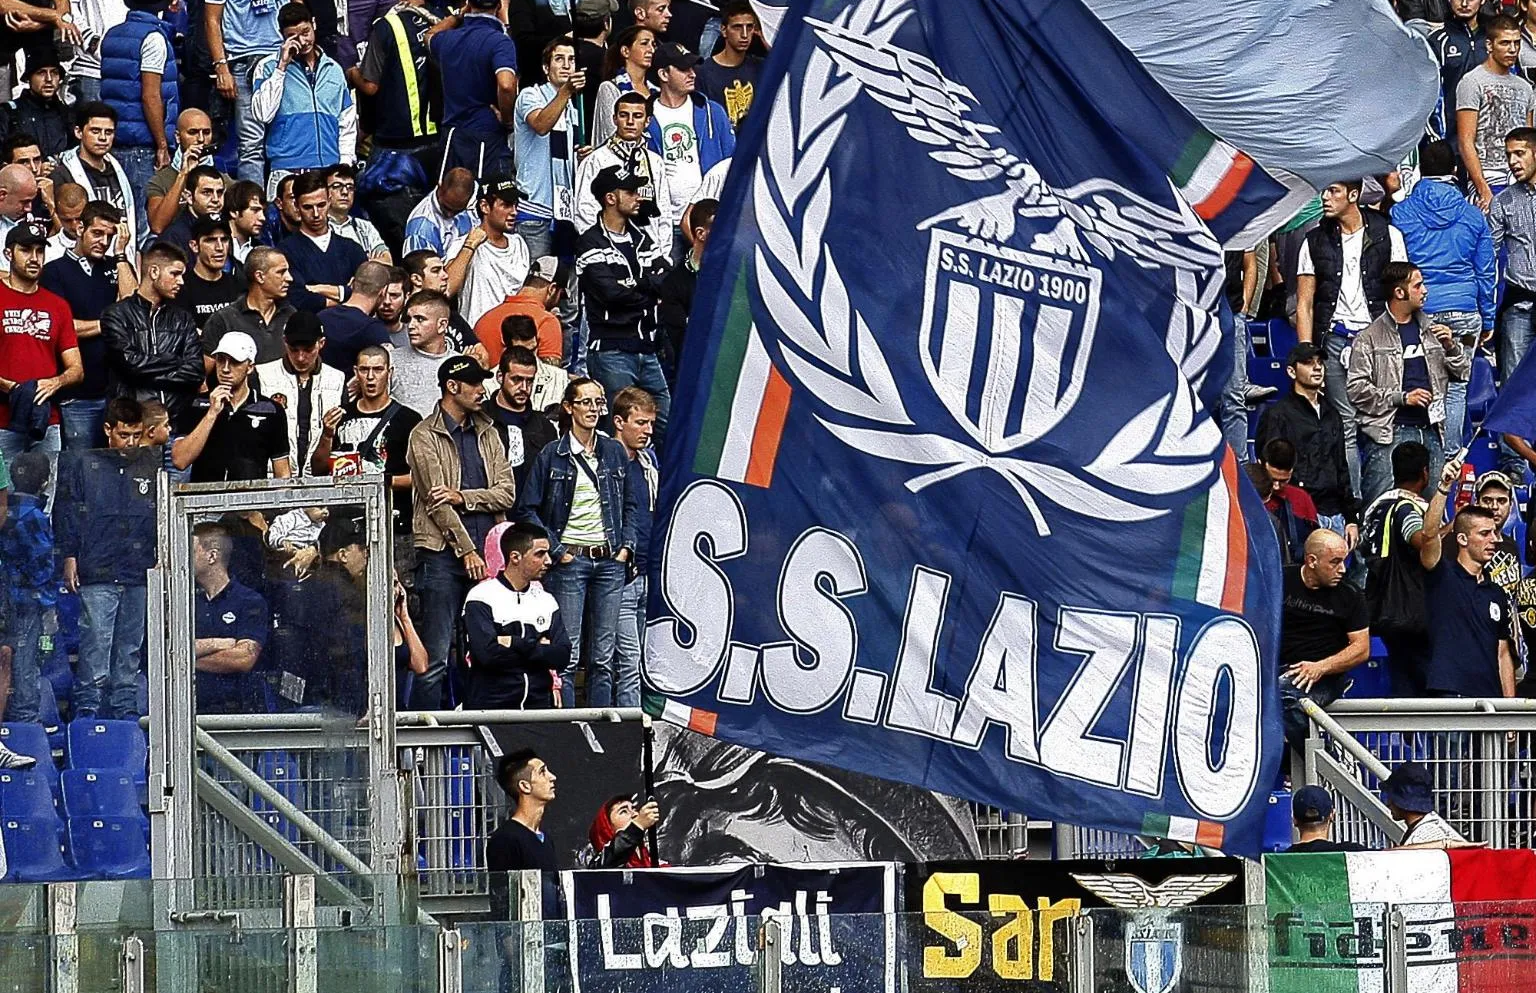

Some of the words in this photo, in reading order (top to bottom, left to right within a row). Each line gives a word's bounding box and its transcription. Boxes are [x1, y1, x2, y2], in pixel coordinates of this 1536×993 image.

[940, 247, 974, 276] S.S.
[978, 256, 1034, 294] LAZIO
[1038, 272, 1087, 304] 1900
[922, 872, 1082, 982] Sar
